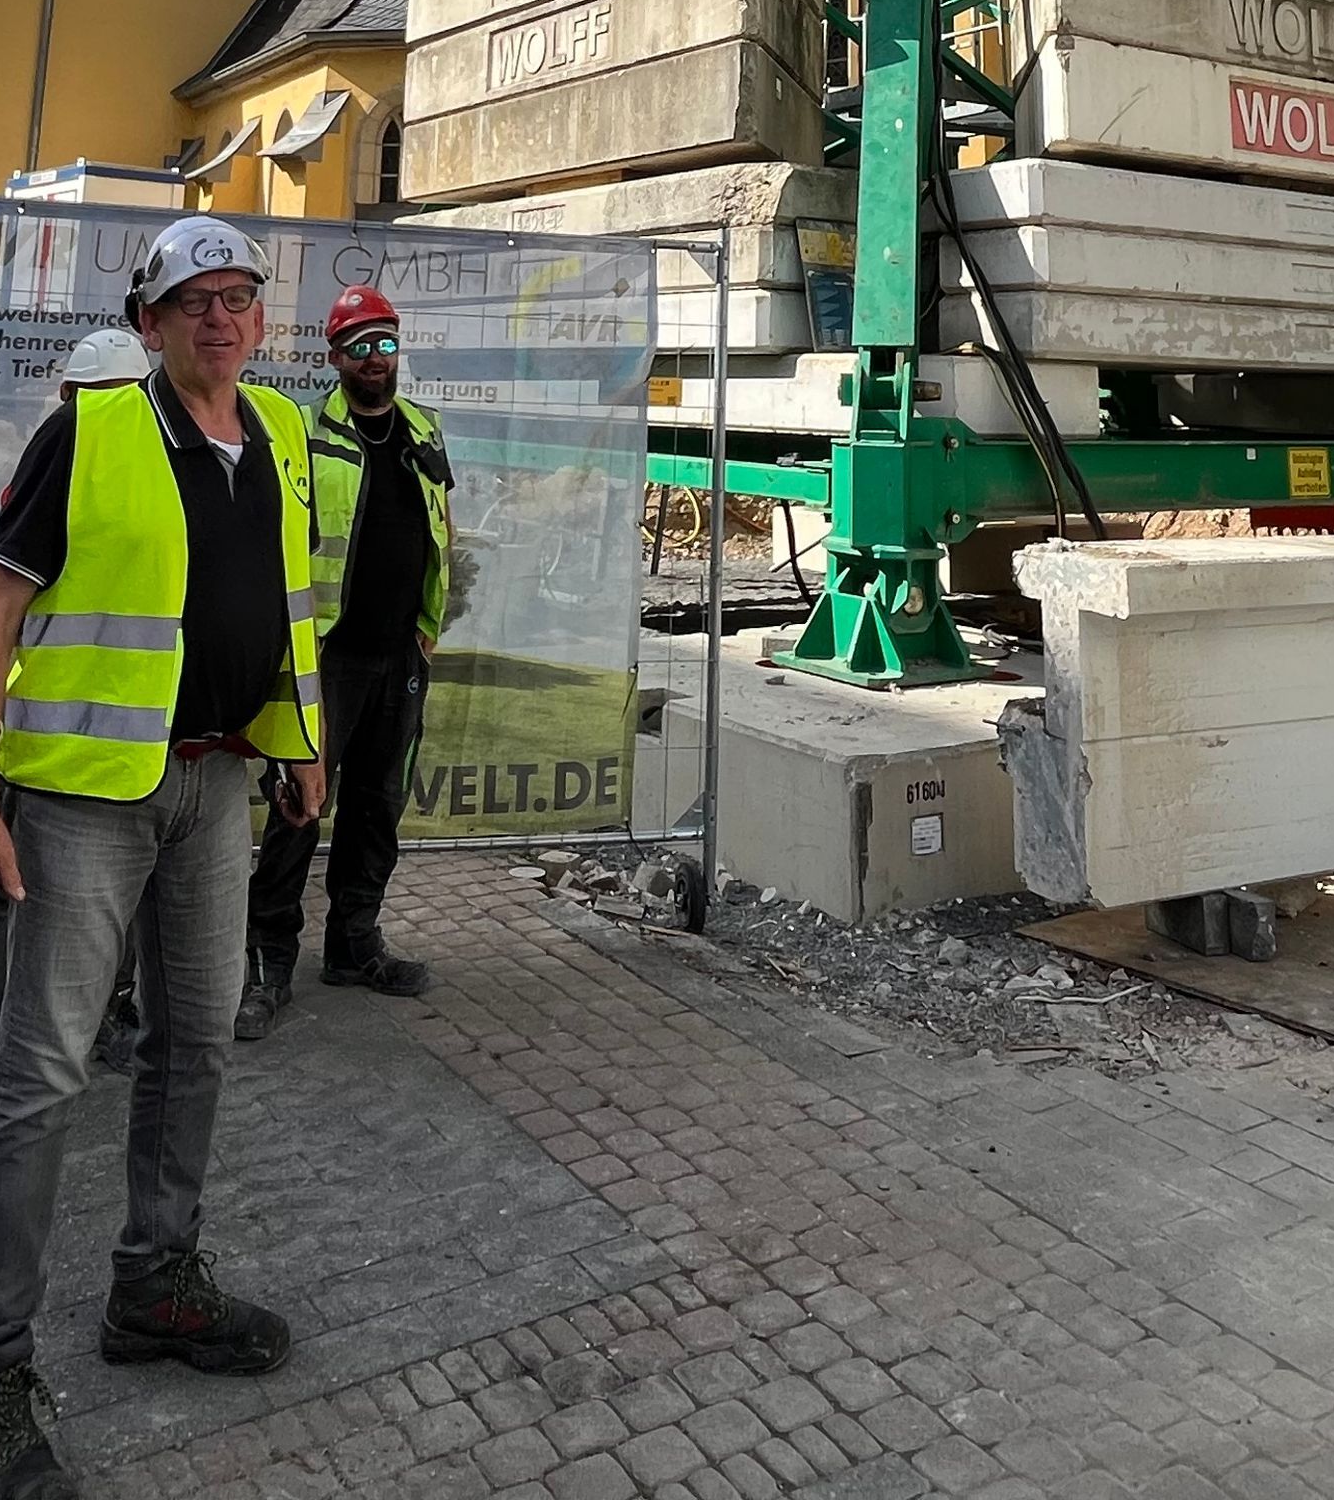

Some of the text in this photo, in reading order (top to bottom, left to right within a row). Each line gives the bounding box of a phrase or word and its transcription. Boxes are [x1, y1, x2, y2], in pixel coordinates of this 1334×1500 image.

[492, 2, 612, 84] WOLFF
[331, 245, 491, 296] GMBH
[12, 358, 65, 379] Tief-
